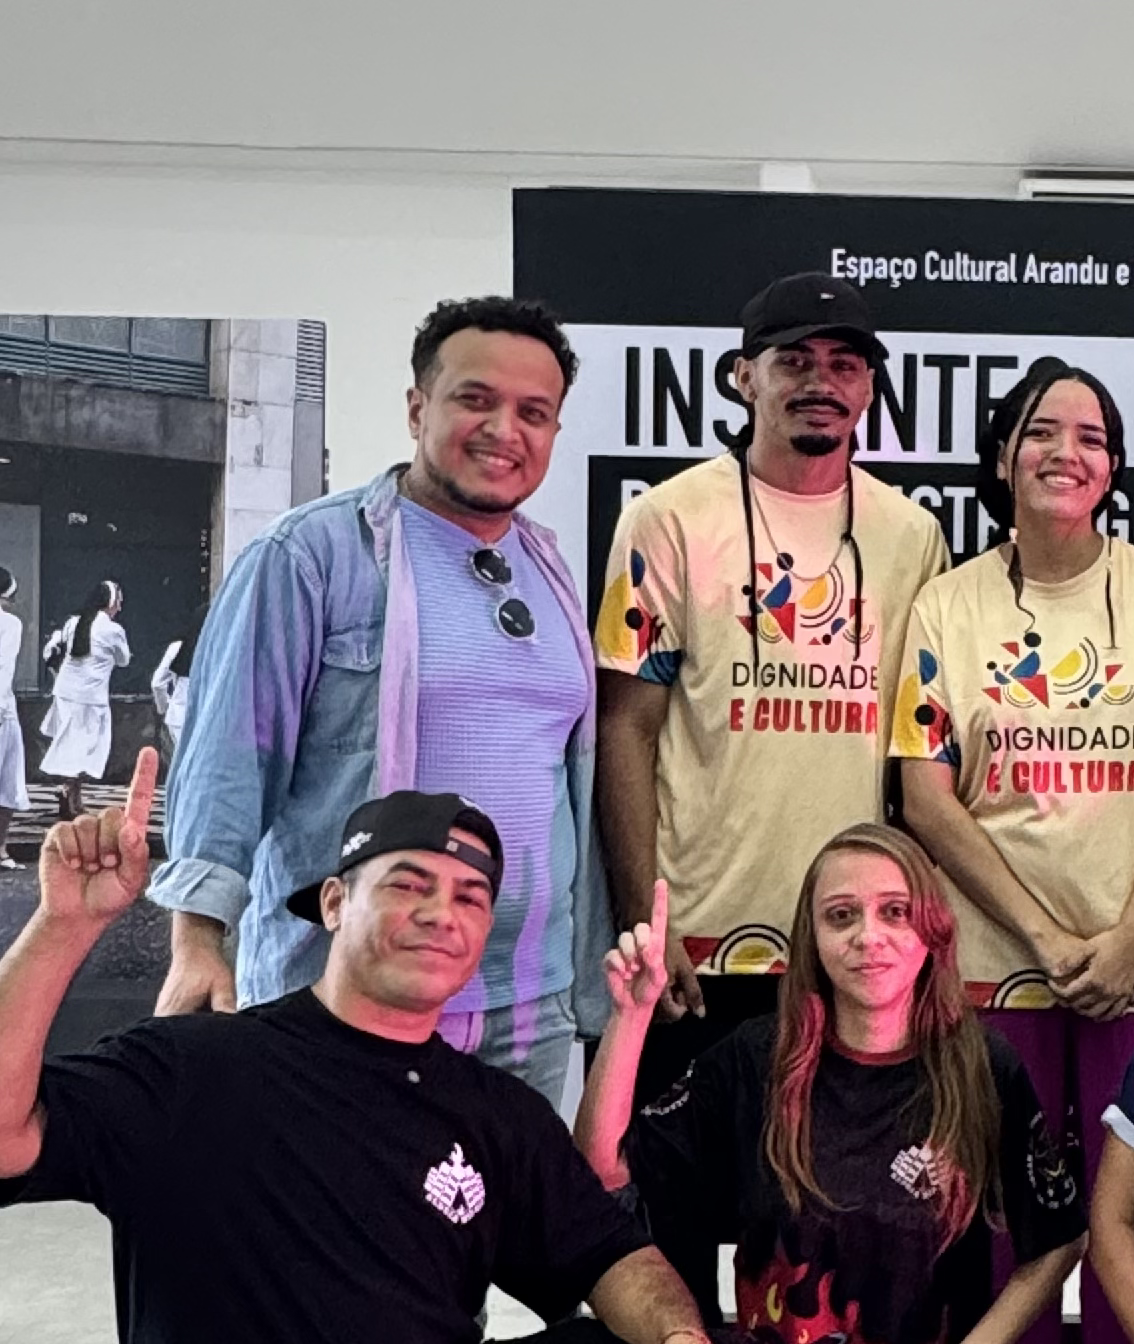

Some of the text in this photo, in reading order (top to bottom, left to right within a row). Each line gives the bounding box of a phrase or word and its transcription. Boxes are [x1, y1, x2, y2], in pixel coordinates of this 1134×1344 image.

[830, 248, 918, 288] Espaço
[924, 250, 1018, 283] Cultural
[1022, 254, 1109, 286] Arandu
[1115, 262, 1130, 285] e
[624, 346, 1020, 454] INSNTE
[732, 662, 880, 690] DIGNIDADE
[729, 696, 878, 734] E CULTURA
